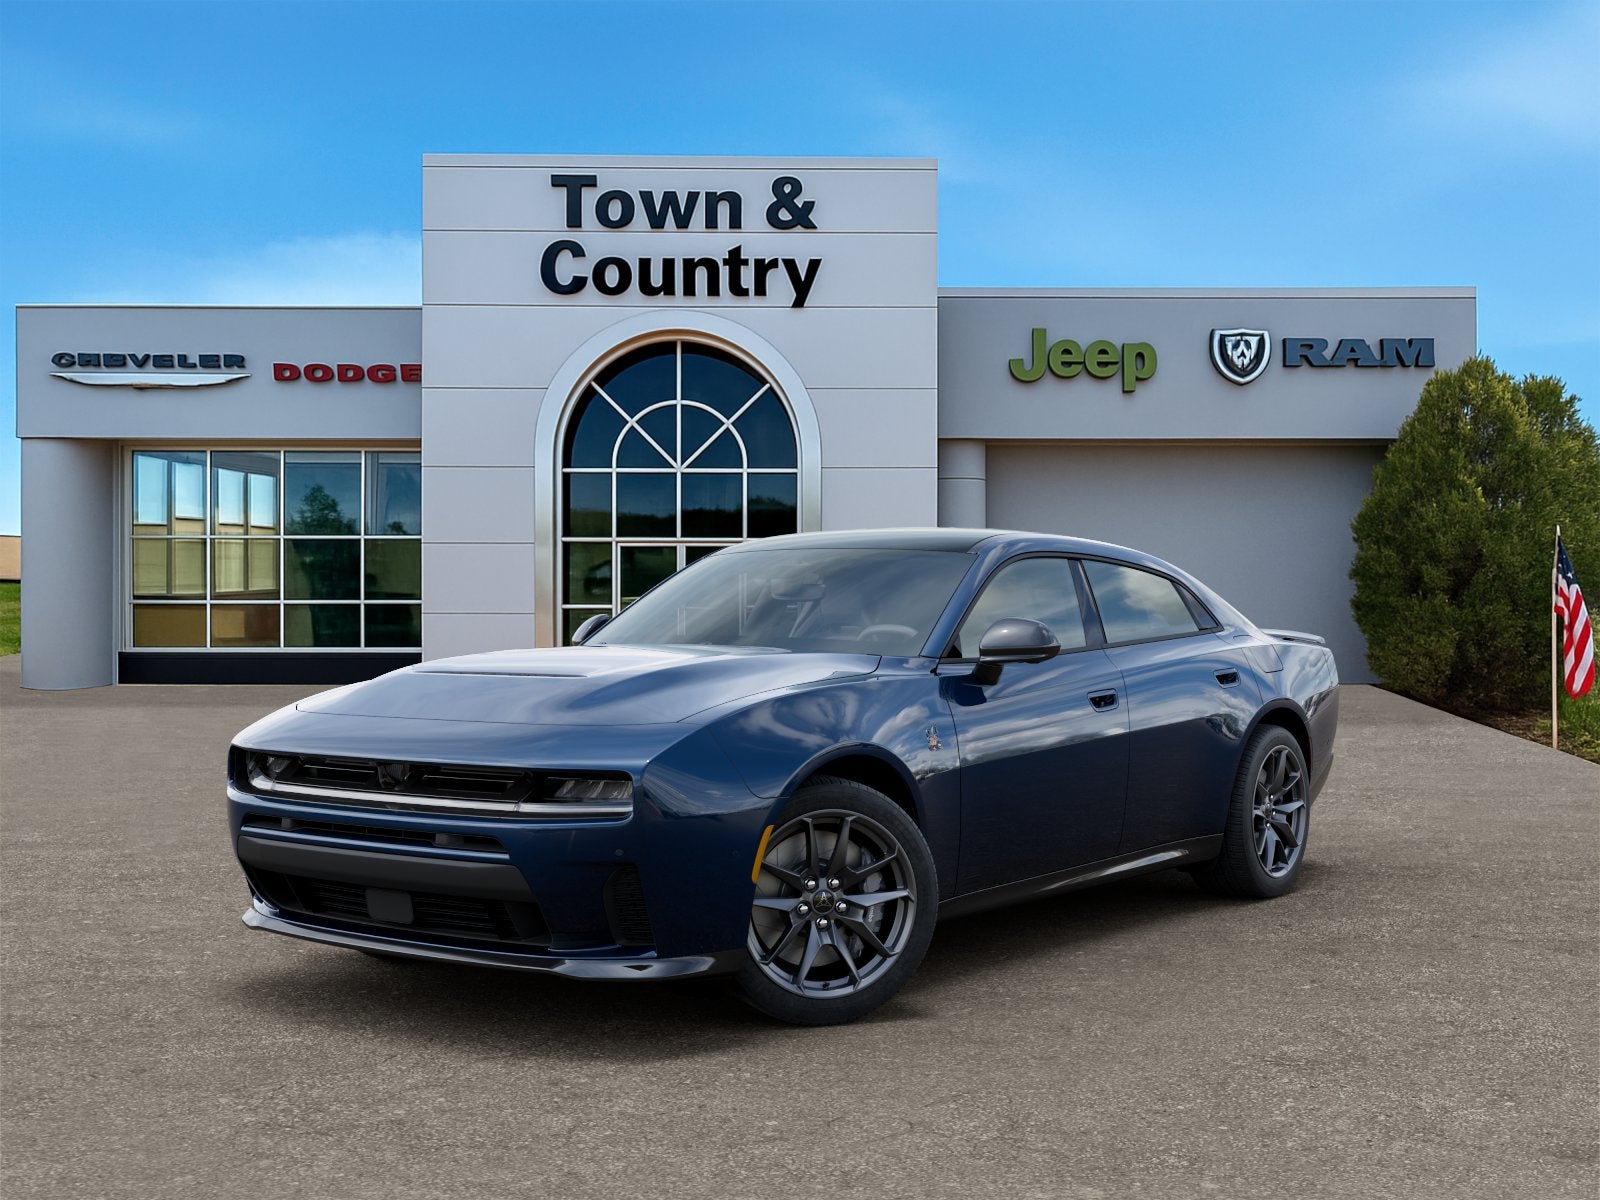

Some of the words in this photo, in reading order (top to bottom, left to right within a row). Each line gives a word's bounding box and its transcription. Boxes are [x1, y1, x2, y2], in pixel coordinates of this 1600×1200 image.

[550, 174, 742, 229] Town
[766, 176, 818, 229] &
[540, 239, 822, 308] Country
[273, 362, 422, 383] DODGE
[1009, 327, 1157, 392] Jeep
[1282, 337, 1435, 368] RAM
